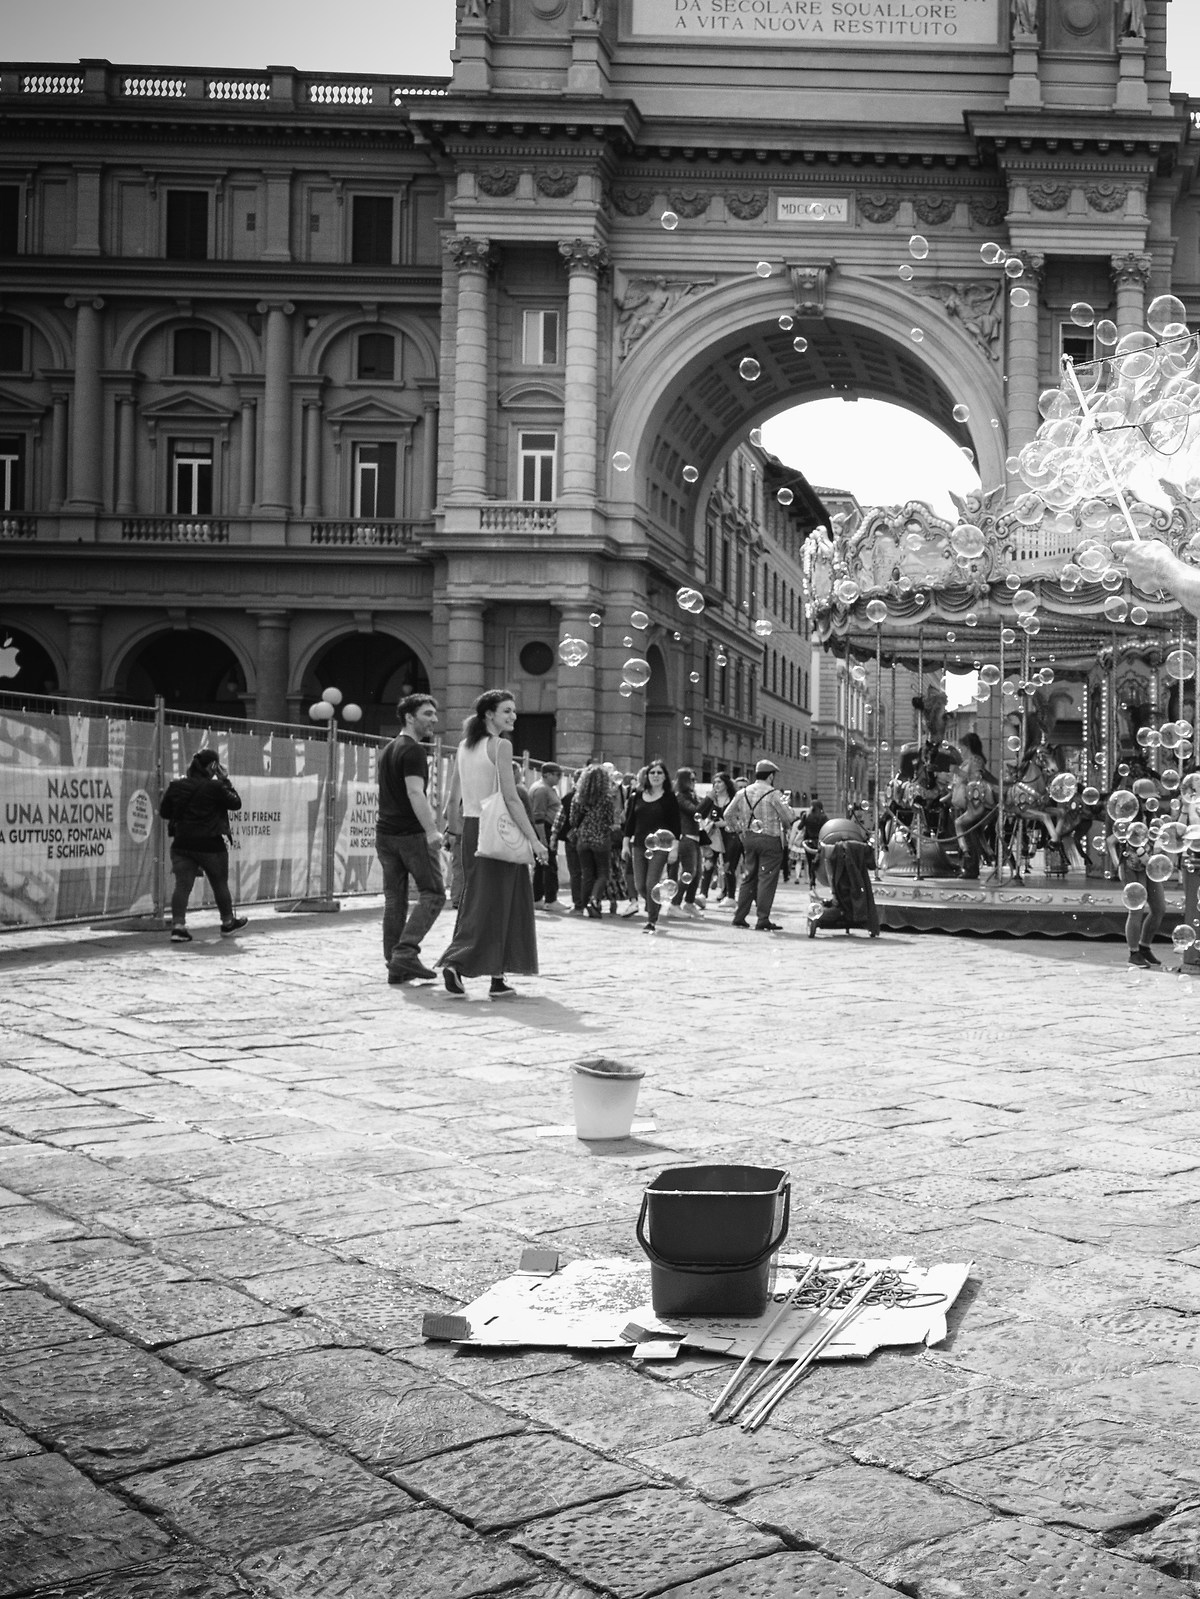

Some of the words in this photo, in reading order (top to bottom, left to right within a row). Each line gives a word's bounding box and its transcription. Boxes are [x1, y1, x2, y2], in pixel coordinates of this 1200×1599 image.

[675, 0, 702, 12] DA
[712, 0, 822, 15] SECOLARE
[832, 2, 957, 18] SQUALLORE
[675, 16, 687, 29] A
[697, 16, 744, 30] VITA
[754, 17, 824, 33] NUOVA
[834, 19, 957, 36] RESTITUITO
[47, 778, 113, 799] NASCITA
[5, 803, 44, 824] UNA
[48, 804, 114, 824] NAZIONE
[252, 812, 281, 822] FIRENZE
[9, 829, 65, 844] GUTTUSO,
[67, 828, 112, 841] FONTANA
[242, 826, 271, 836] VISITARE
[47, 845, 53, 859] E
[57, 843, 105, 859] SCHIFANO
